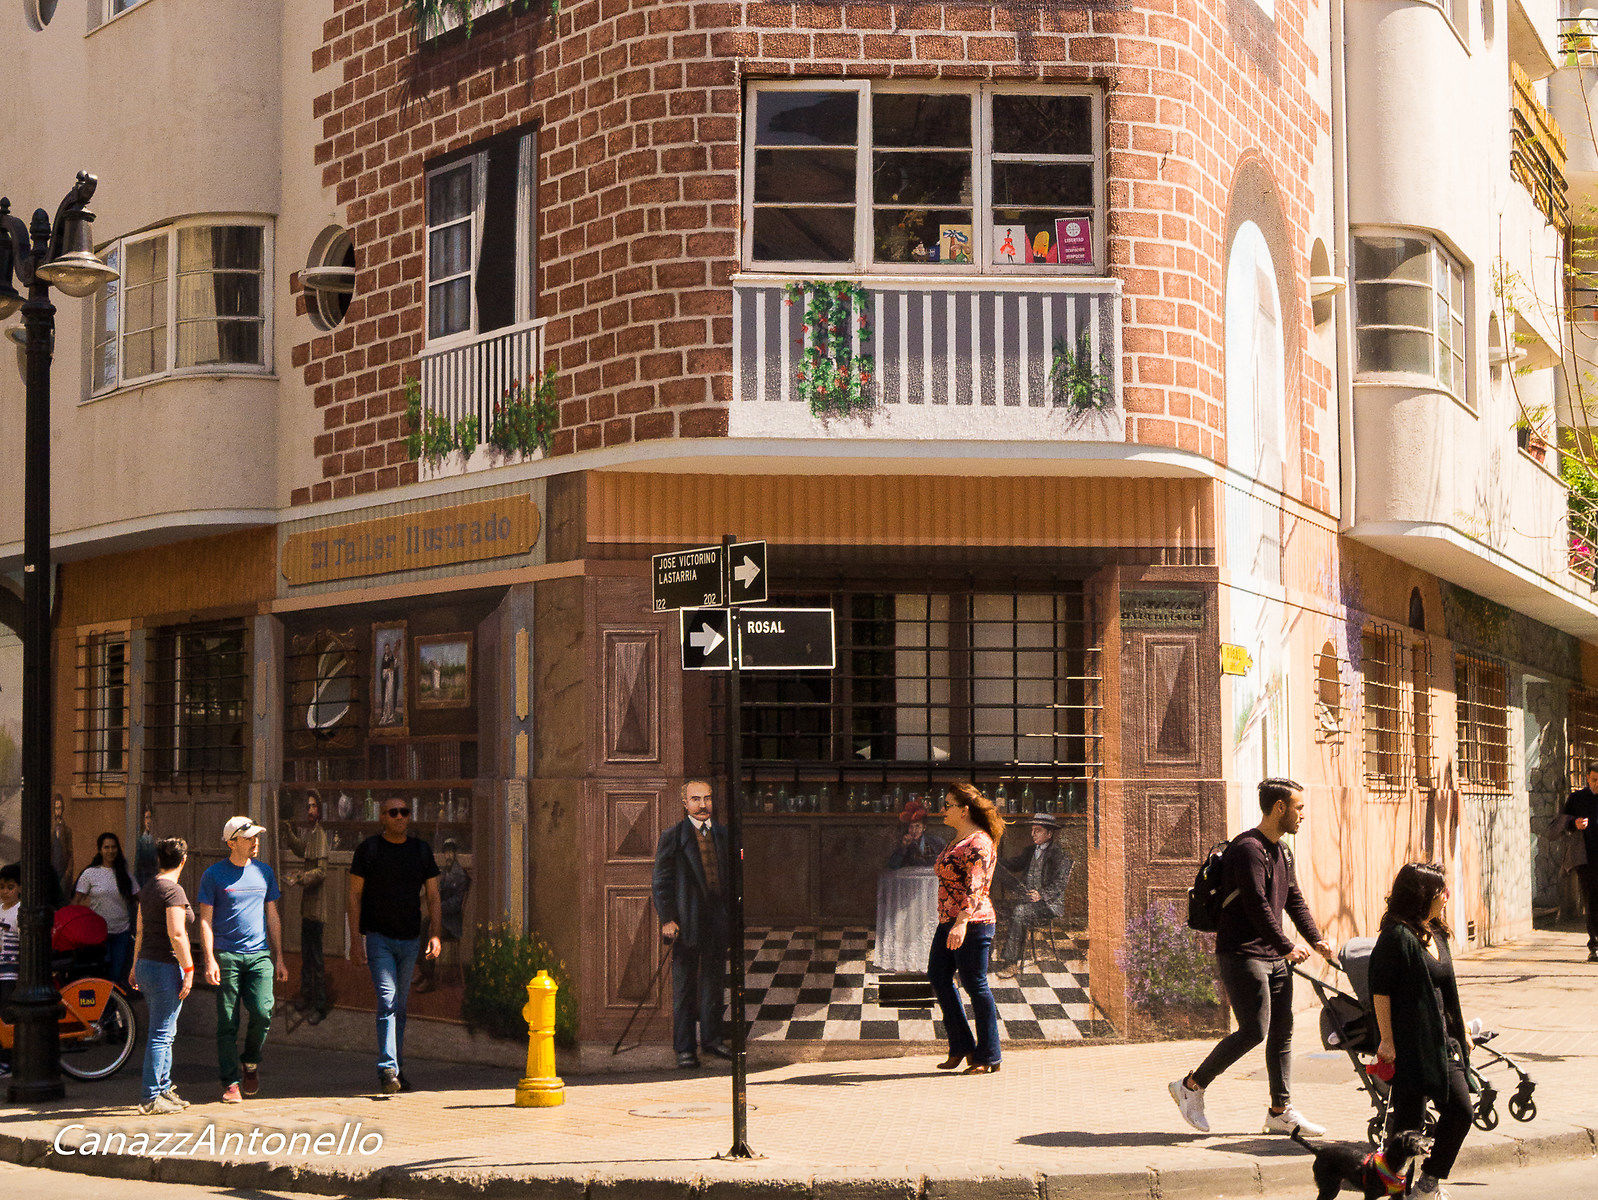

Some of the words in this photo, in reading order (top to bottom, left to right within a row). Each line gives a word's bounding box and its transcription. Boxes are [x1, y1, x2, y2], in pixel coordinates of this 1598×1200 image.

[310, 541, 328, 569] El
[333, 532, 397, 566] Taller
[405, 512, 511, 555] Ilustrado
[658, 557, 676, 570] JOSE
[679, 552, 716, 567] VICTORINO
[658, 570, 697, 585] LASTARRIA
[703, 593, 716, 605] 202
[747, 620, 785, 634] ROSAL
